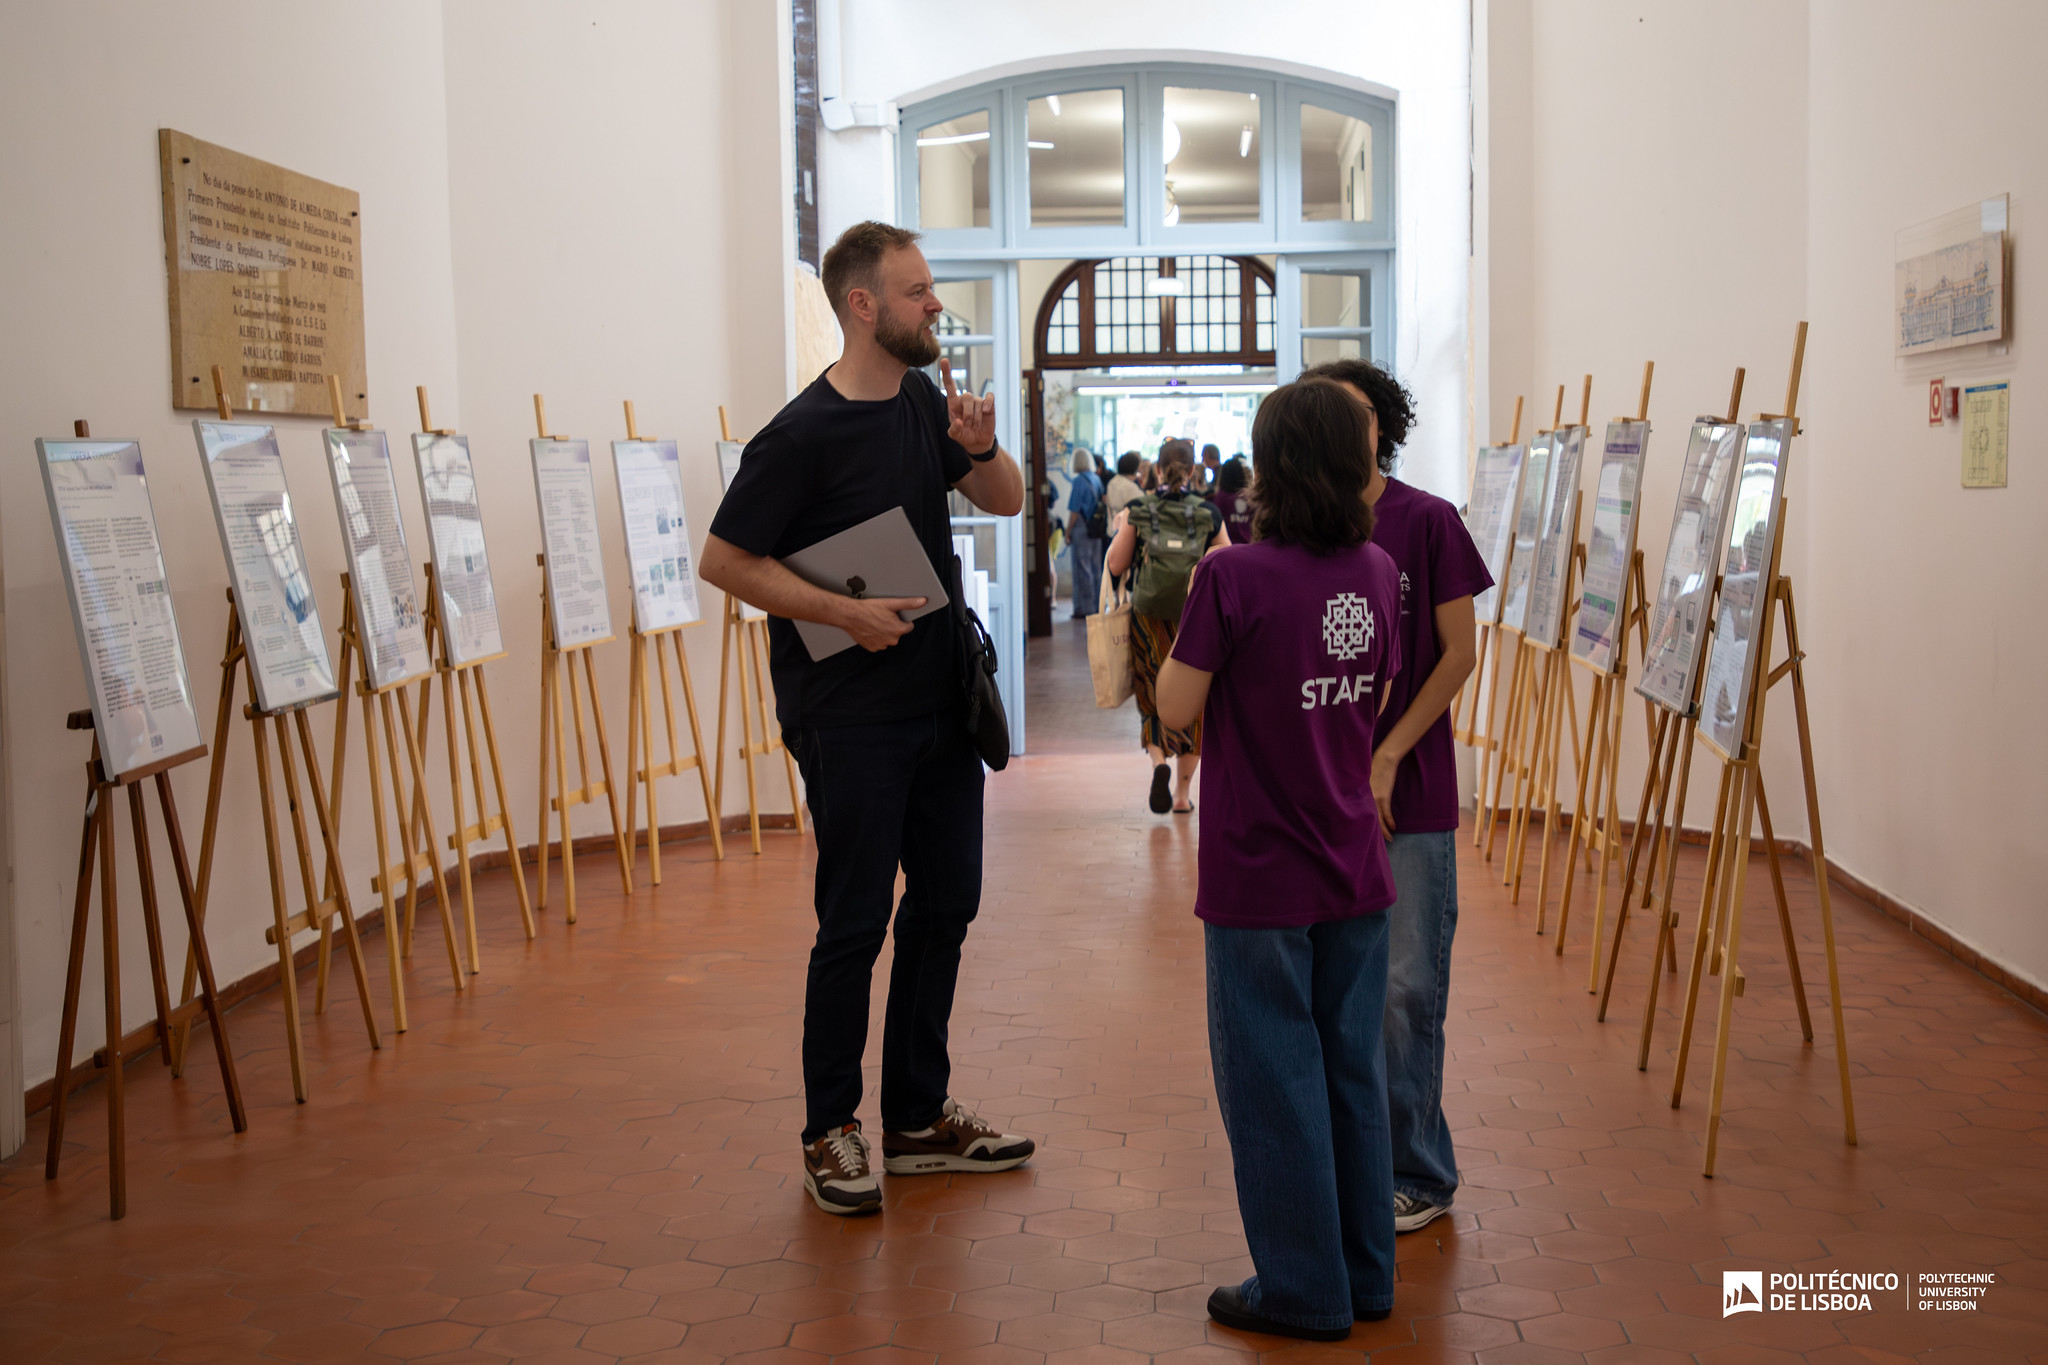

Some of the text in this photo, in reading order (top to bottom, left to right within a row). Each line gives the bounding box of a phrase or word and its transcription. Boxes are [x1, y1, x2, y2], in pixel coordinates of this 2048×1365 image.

[203, 172, 211, 185] No
[213, 175, 222, 188] dia
[290, 199, 297, 211] DE
[299, 202, 322, 218] ALMEIDA
[323, 209, 338, 223] COSTA
[188, 188, 214, 207] Primeiro
[216, 197, 246, 215] Presidente
[331, 229, 337, 240] de
[223, 218, 239, 233] honra
[242, 223, 249, 236] de
[252, 226, 272, 242] receber
[190, 230, 221, 249] Presidente
[226, 239, 233, 252] da
[333, 265, 354, 280] ALBERTO
[191, 253, 260, 279] NOBRE LOPES SOARES
[232, 285, 242, 297] Aos
[252, 288, 263, 301] dias
[284, 295, 291, 306] de
[309, 300, 316, 311] de
[239, 325, 265, 340] ALBERTO
[274, 330, 293, 344] ANTAS
[294, 333, 301, 345] DE
[304, 335, 324, 348] BARROS
[300, 353, 322, 366] BARROS
[250, 366, 270, 379] ISABEL
[299, 371, 324, 385] BAPTISTA
[1301, 674, 1374, 710] STAF
